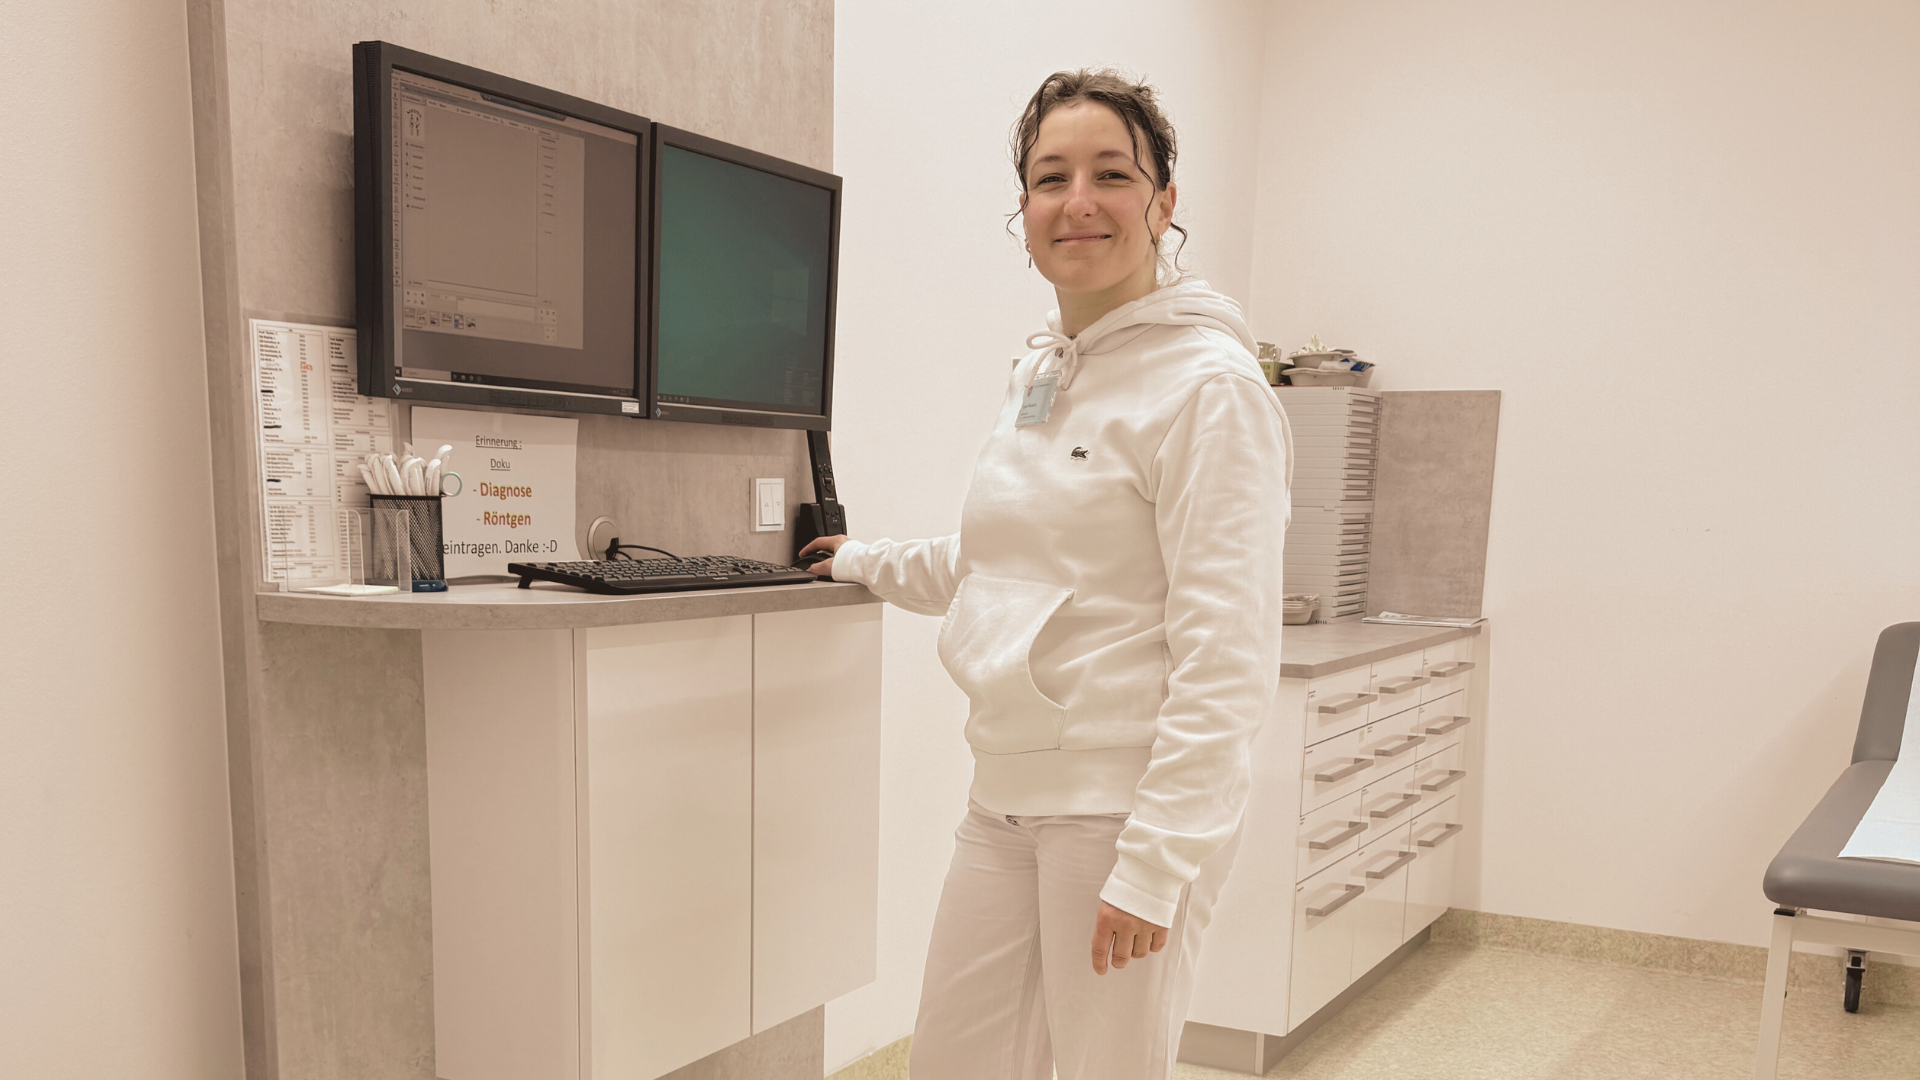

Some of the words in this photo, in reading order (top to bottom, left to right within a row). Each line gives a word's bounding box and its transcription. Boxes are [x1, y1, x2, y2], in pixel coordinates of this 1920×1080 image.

[475, 435, 518, 449] Erinnerung
[490, 458, 511, 470] Doku
[480, 482, 532, 500] Diagnose
[483, 511, 531, 529] Röntgen
[443, 540, 502, 558] eintragen.
[505, 539, 539, 554] Danke
[542, 539, 558, 553] :-D
